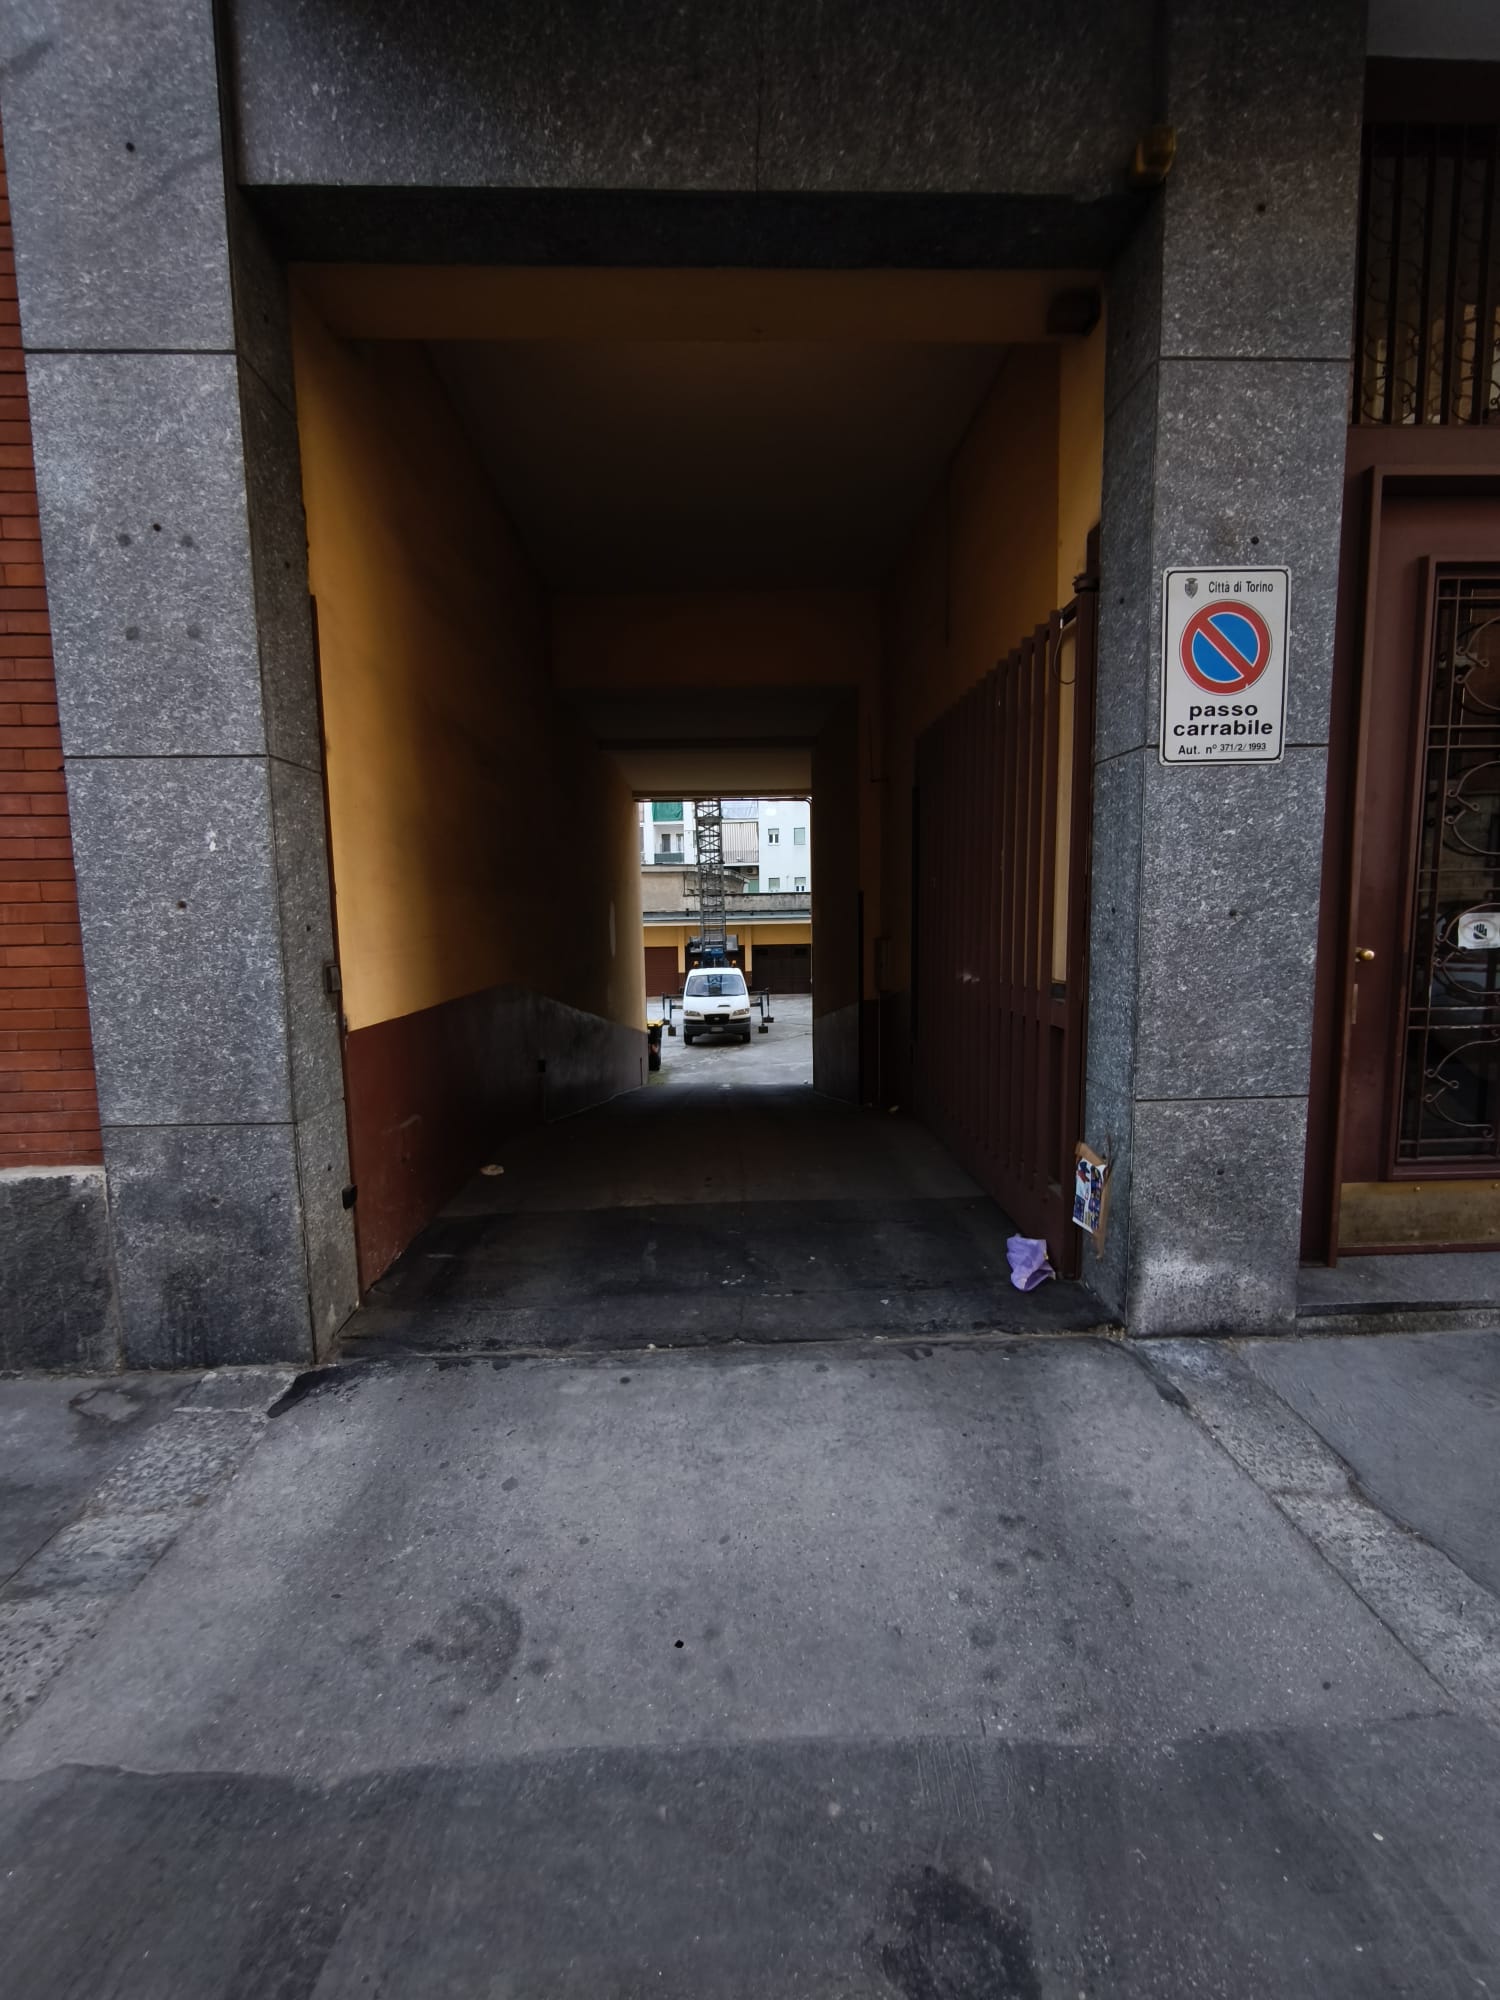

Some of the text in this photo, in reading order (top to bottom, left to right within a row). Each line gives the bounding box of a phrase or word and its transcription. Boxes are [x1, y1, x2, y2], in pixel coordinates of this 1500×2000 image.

[1208, 580, 1274, 593] Città di Torino
[1189, 704, 1258, 720] passo
[1173, 720, 1273, 736] carrabile
[1178, 745, 1201, 755] Aut.
